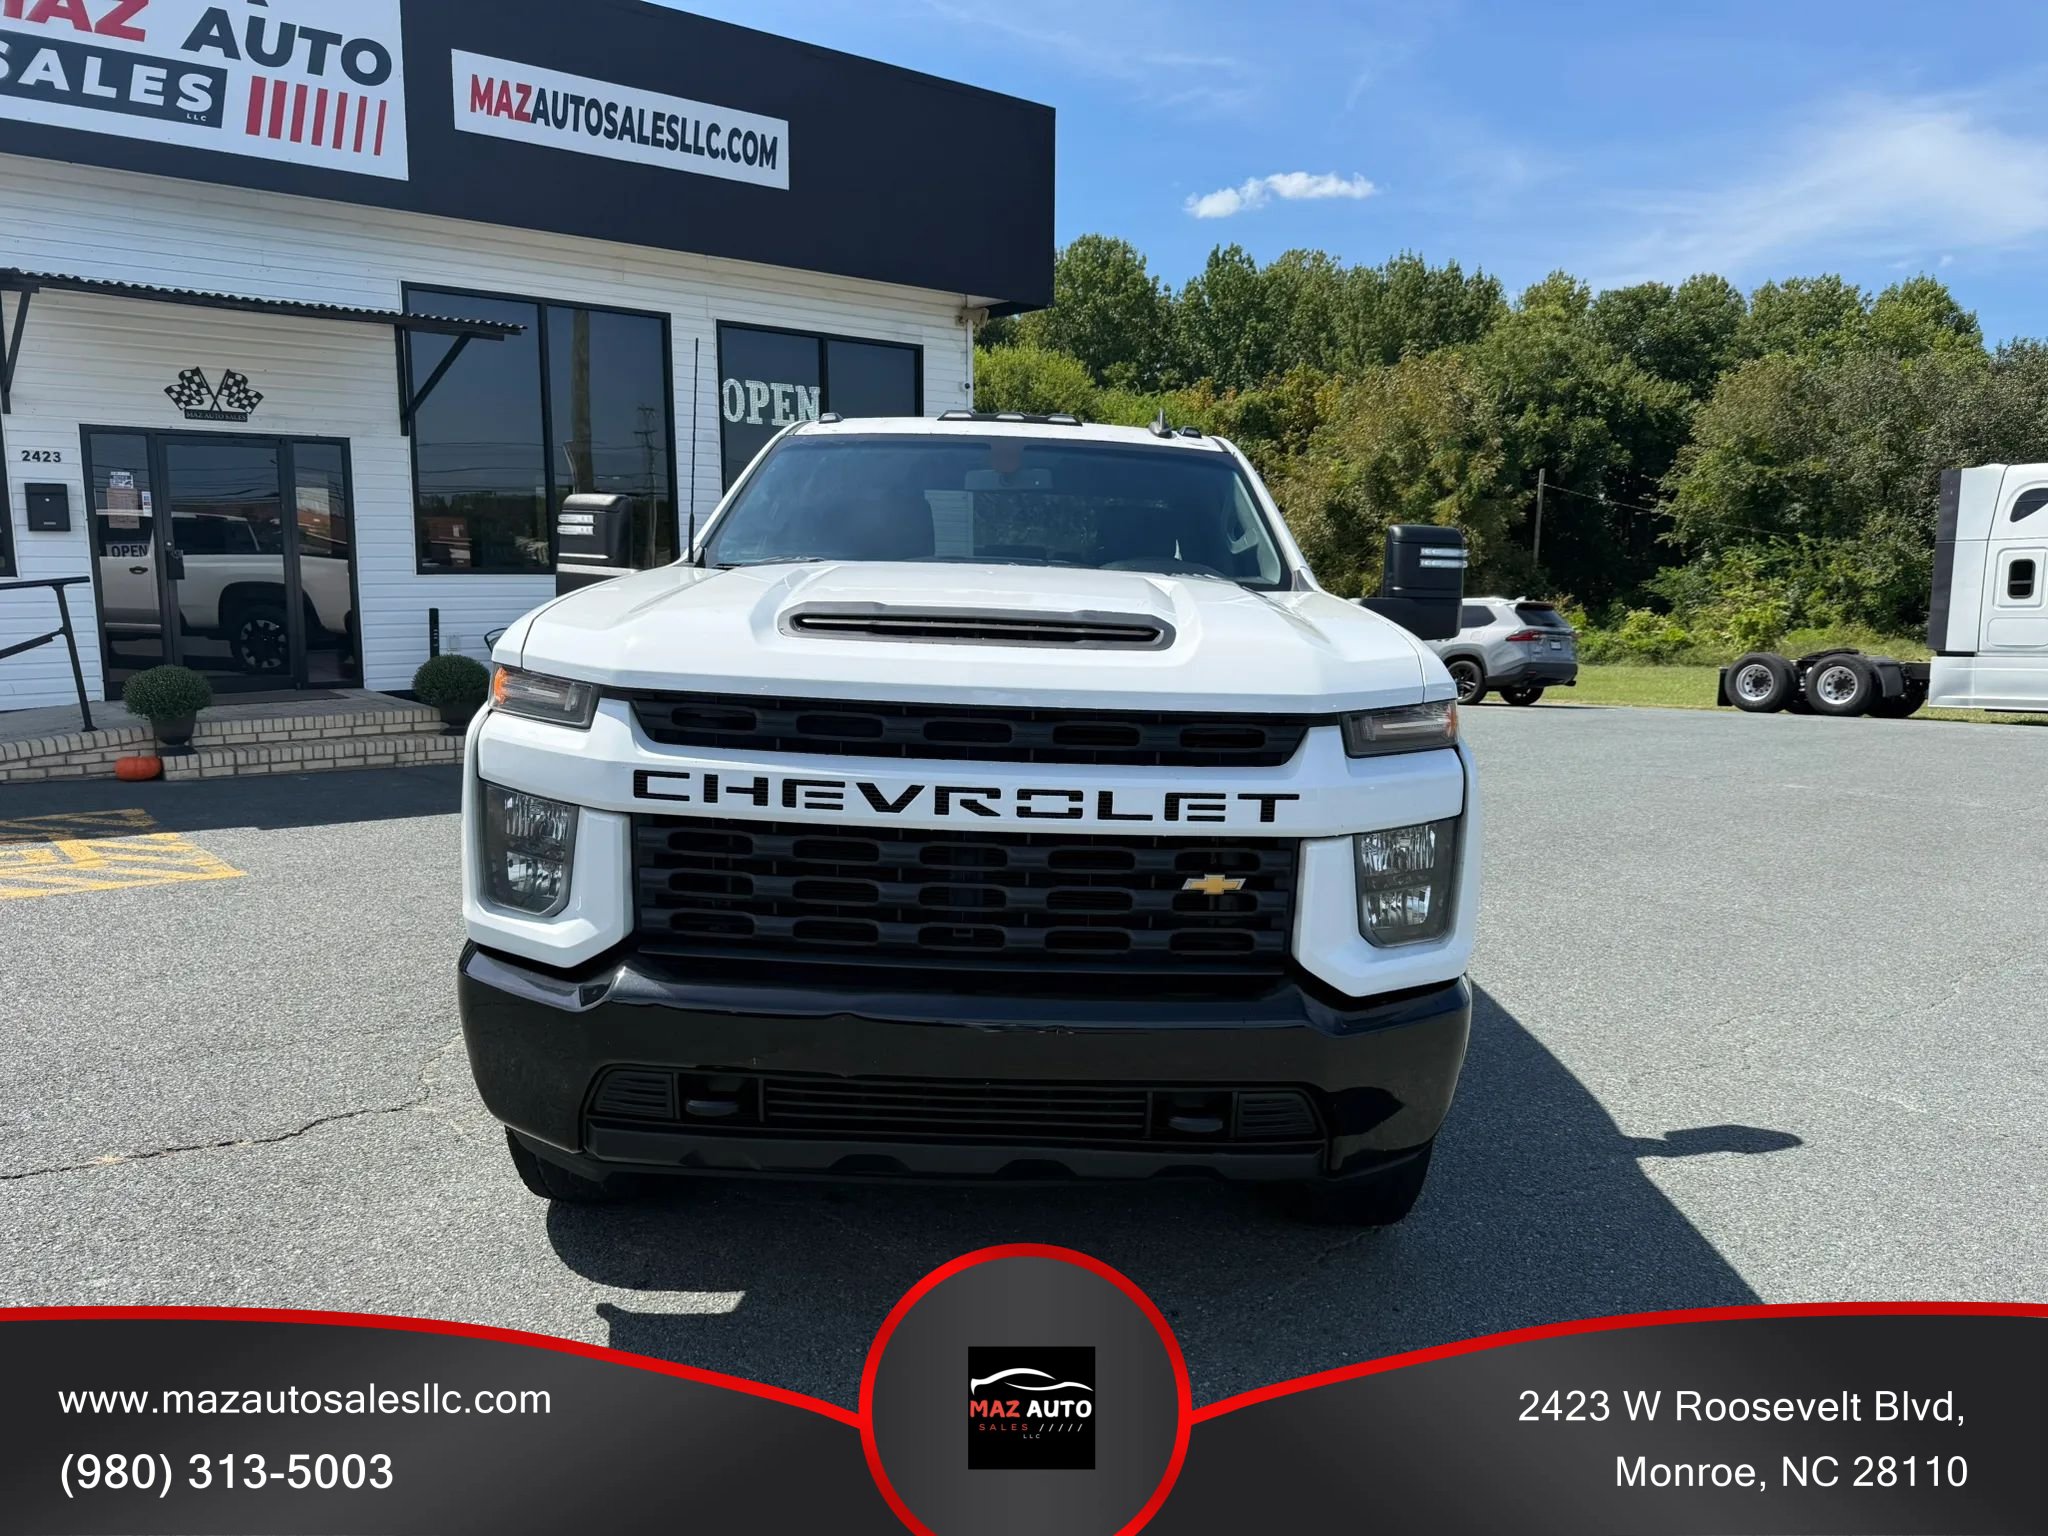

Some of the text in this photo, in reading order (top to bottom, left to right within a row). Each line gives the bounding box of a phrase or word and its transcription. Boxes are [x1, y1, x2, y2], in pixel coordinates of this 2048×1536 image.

[3, 0, 393, 87] AZ AUTO
[0, 40, 213, 113] ALES
[186, 113, 207, 122] LLC
[470, 73, 778, 170] MAZAUTOSALESLLC.COM
[722, 378, 820, 427] OPEN
[21, 450, 62, 463] 2423
[111, 545, 147, 557] OPEN
[633, 769, 1299, 823] CHEVROLET
